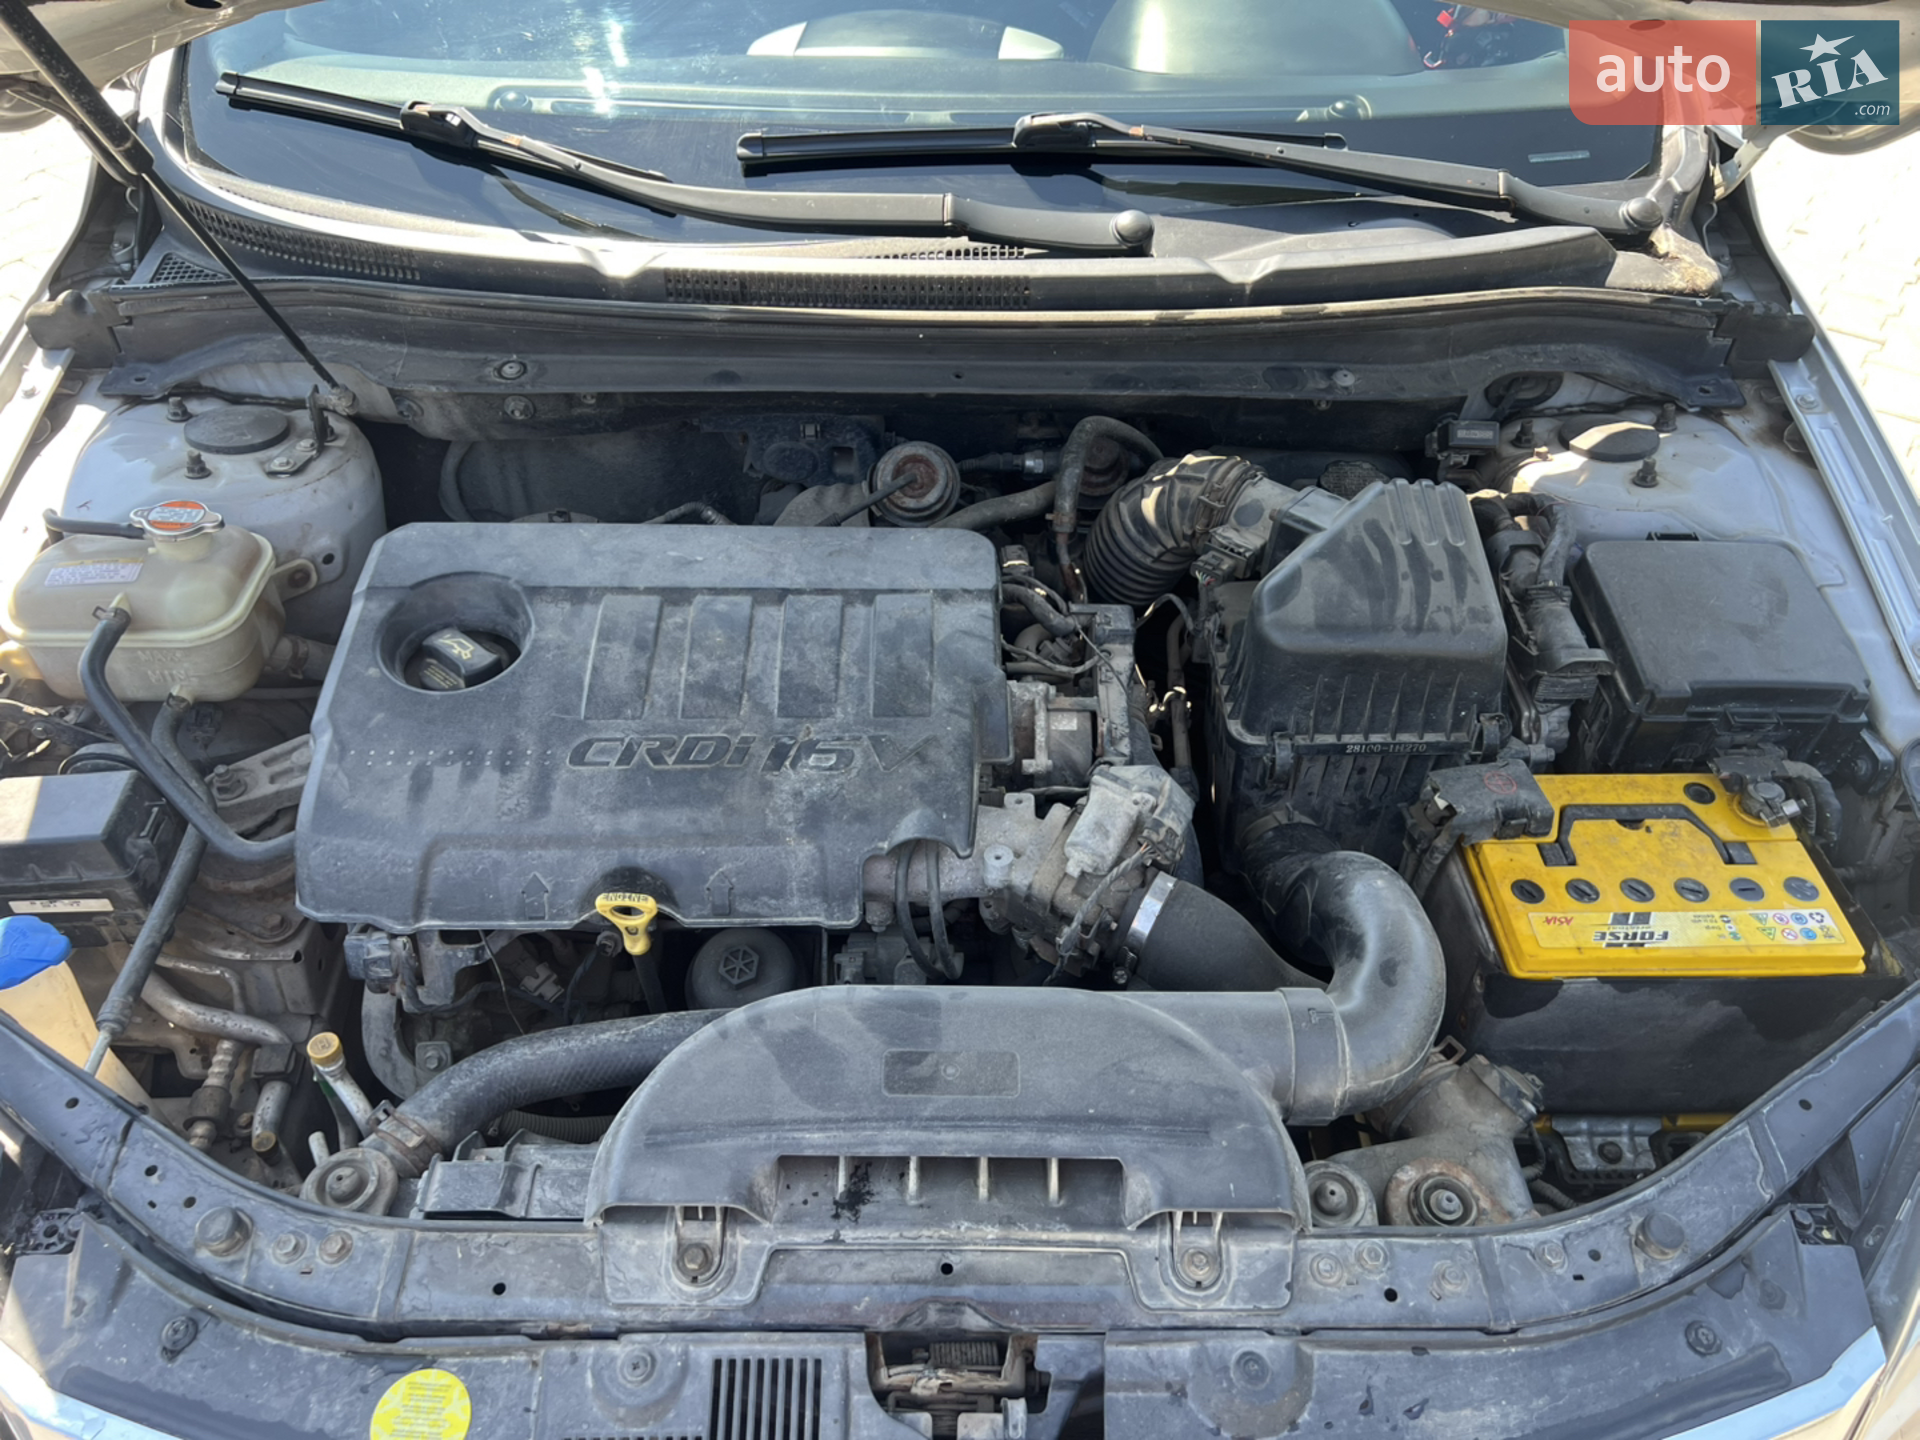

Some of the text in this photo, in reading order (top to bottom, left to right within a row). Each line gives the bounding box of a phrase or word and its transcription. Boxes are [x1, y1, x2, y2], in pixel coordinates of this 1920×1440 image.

[567, 734, 941, 774] CRDi 16V
[1543, 916, 1574, 926] ASIA
[1593, 930, 1669, 942] FORSE
